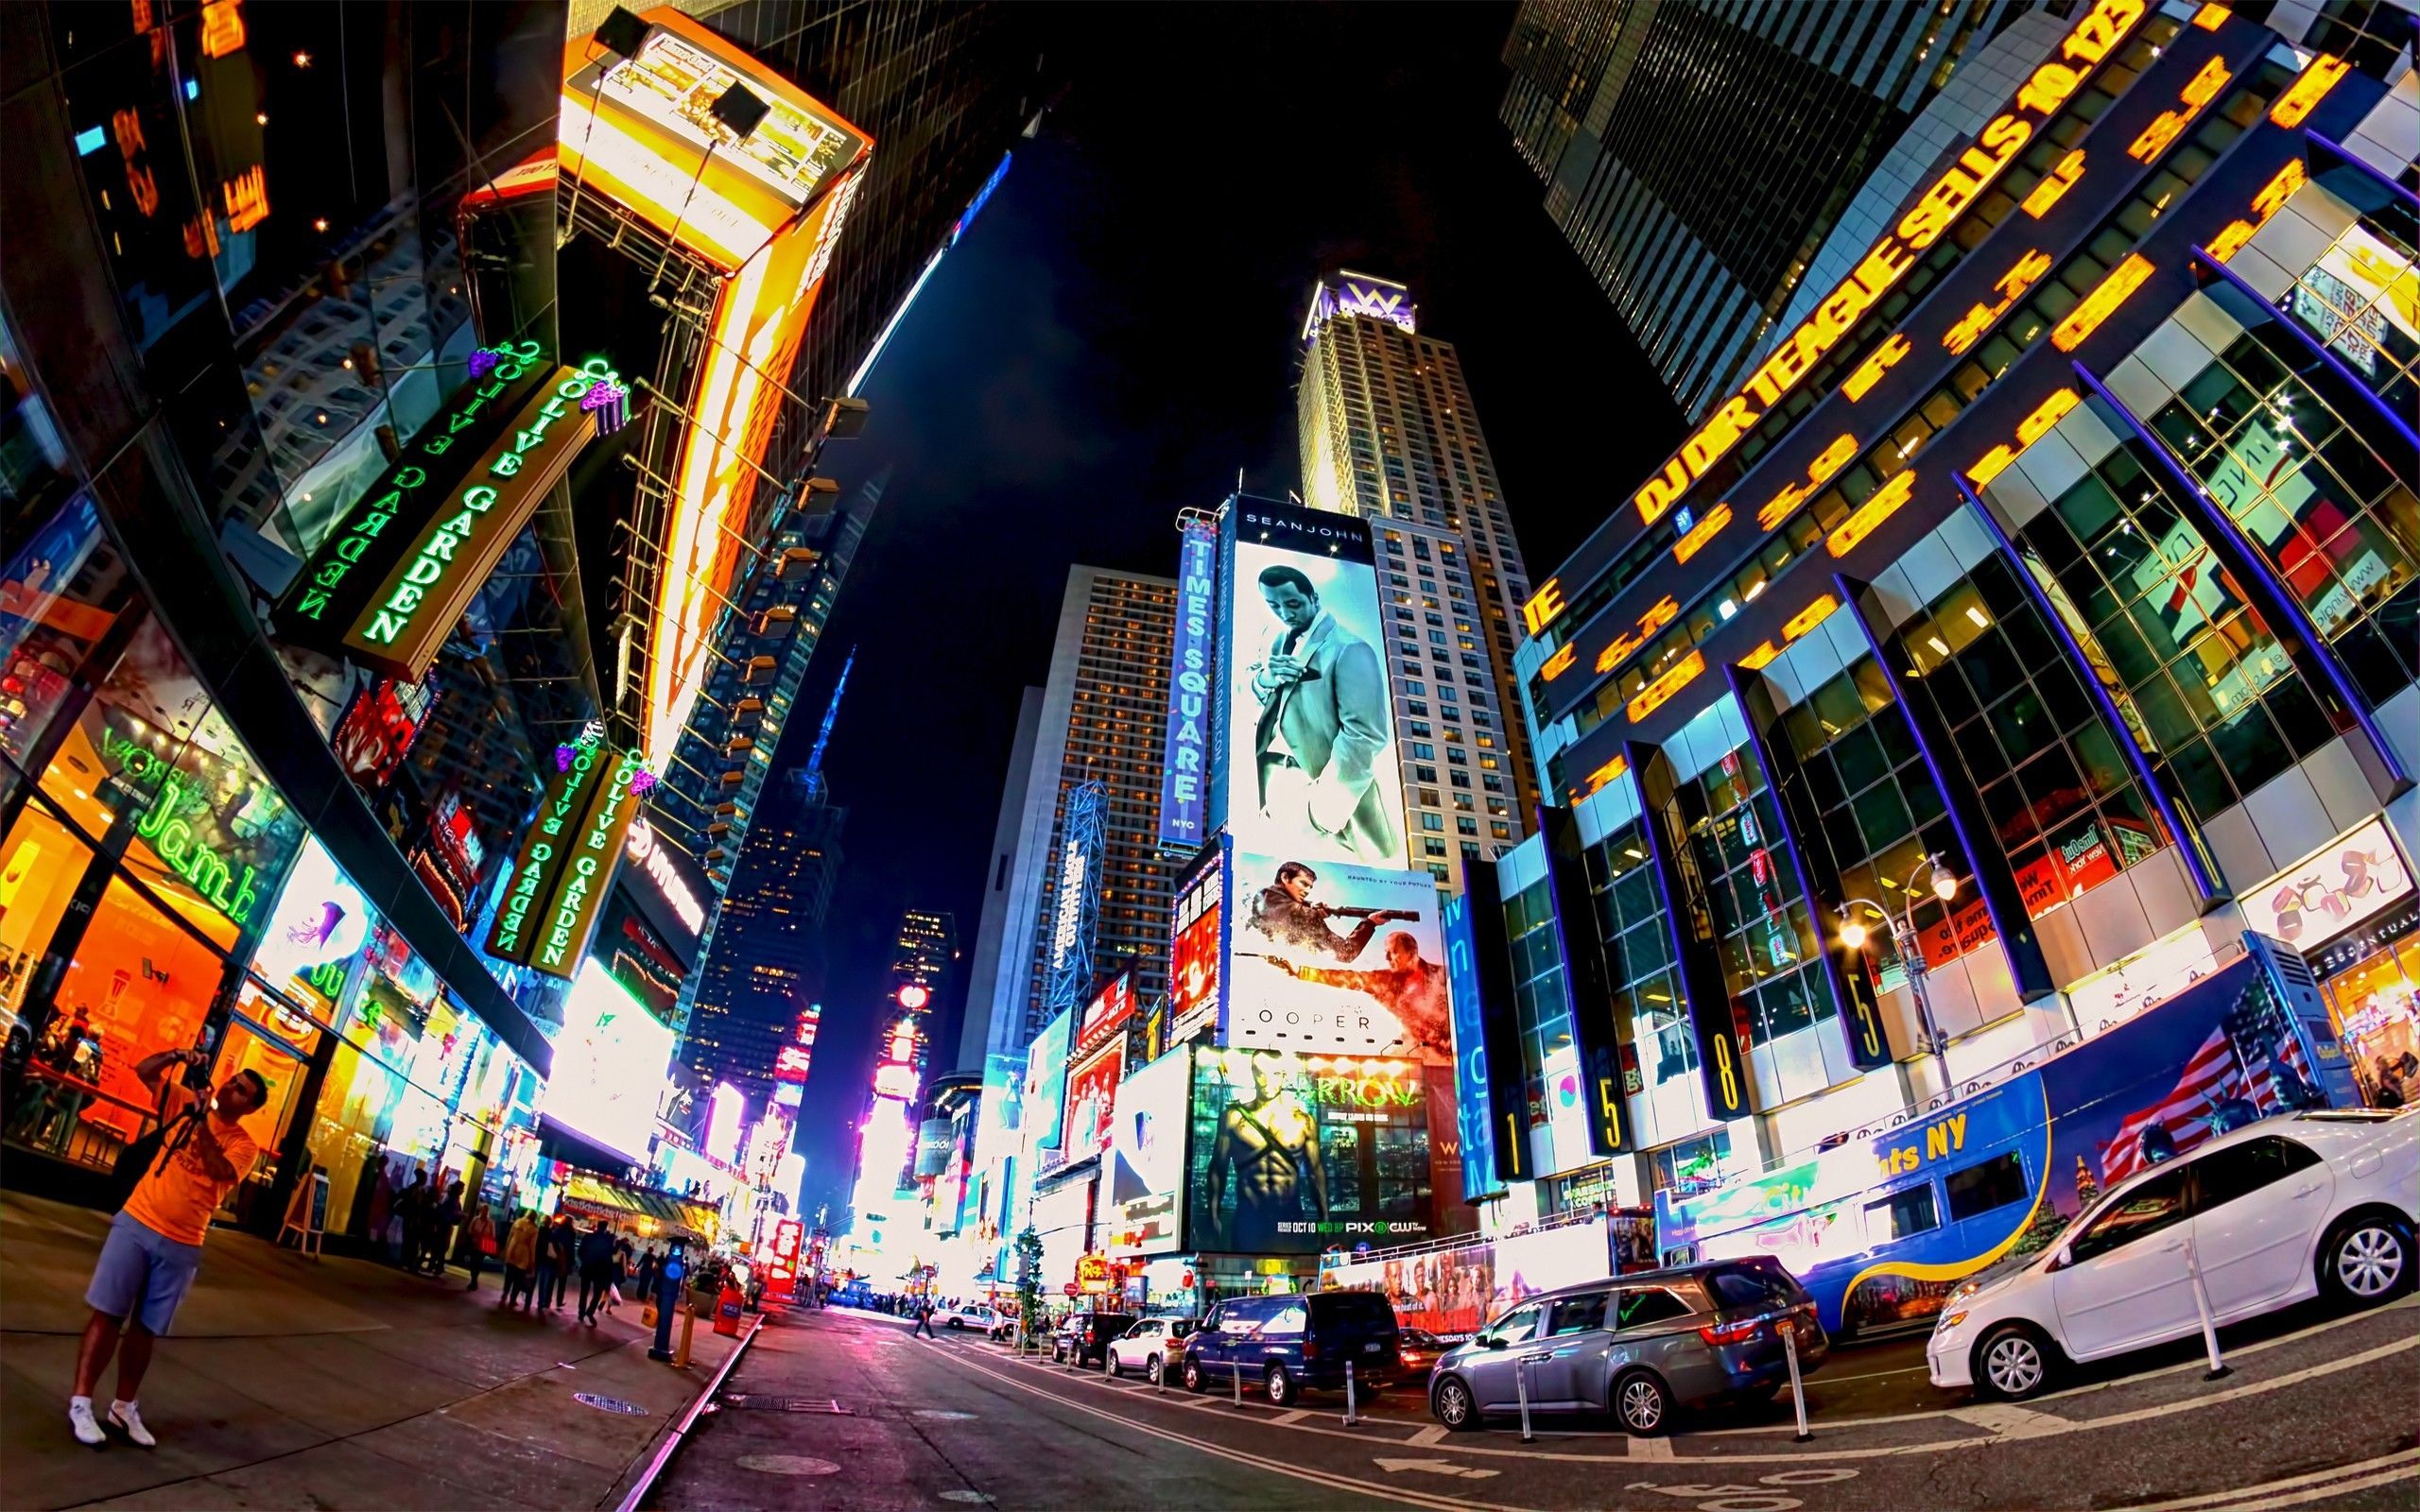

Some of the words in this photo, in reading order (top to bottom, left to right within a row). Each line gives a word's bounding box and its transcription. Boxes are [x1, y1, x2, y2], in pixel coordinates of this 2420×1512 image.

[1347, 283, 1403, 316] W
[1634, 457, 1692, 525] DJ
[1742, 235, 1914, 407] TEAGUE
[1897, 114, 2032, 249] SELLS
[491, 378, 587, 477] OLIVE
[364, 486, 497, 644] GARDEN
[1186, 540, 1212, 636] TIMES
[1174, 648, 1207, 801] SQUARE
[588, 767, 633, 850] OLIVE
[1172, 818, 1195, 830] NYC
[542, 857, 596, 966] GARDEN
[1053, 888, 1073, 969] AMERICAN
[2324, 907, 2420, 971] ESCENTUAL
[1241, 1009, 1370, 1030] OOPER
[1847, 973, 1880, 1057] 5
[1714, 1032, 1739, 1111] 8
[1440, 1141, 1459, 1155] W
[1507, 1112, 1519, 1175] 1
[1599, 1078, 1620, 1148] 5
[1927, 1113, 1967, 1161] NY
[1293, 1222, 1306, 1232] OCT
[1308, 1222, 1316, 1232] 10
[1346, 1222, 1374, 1232] PIX
